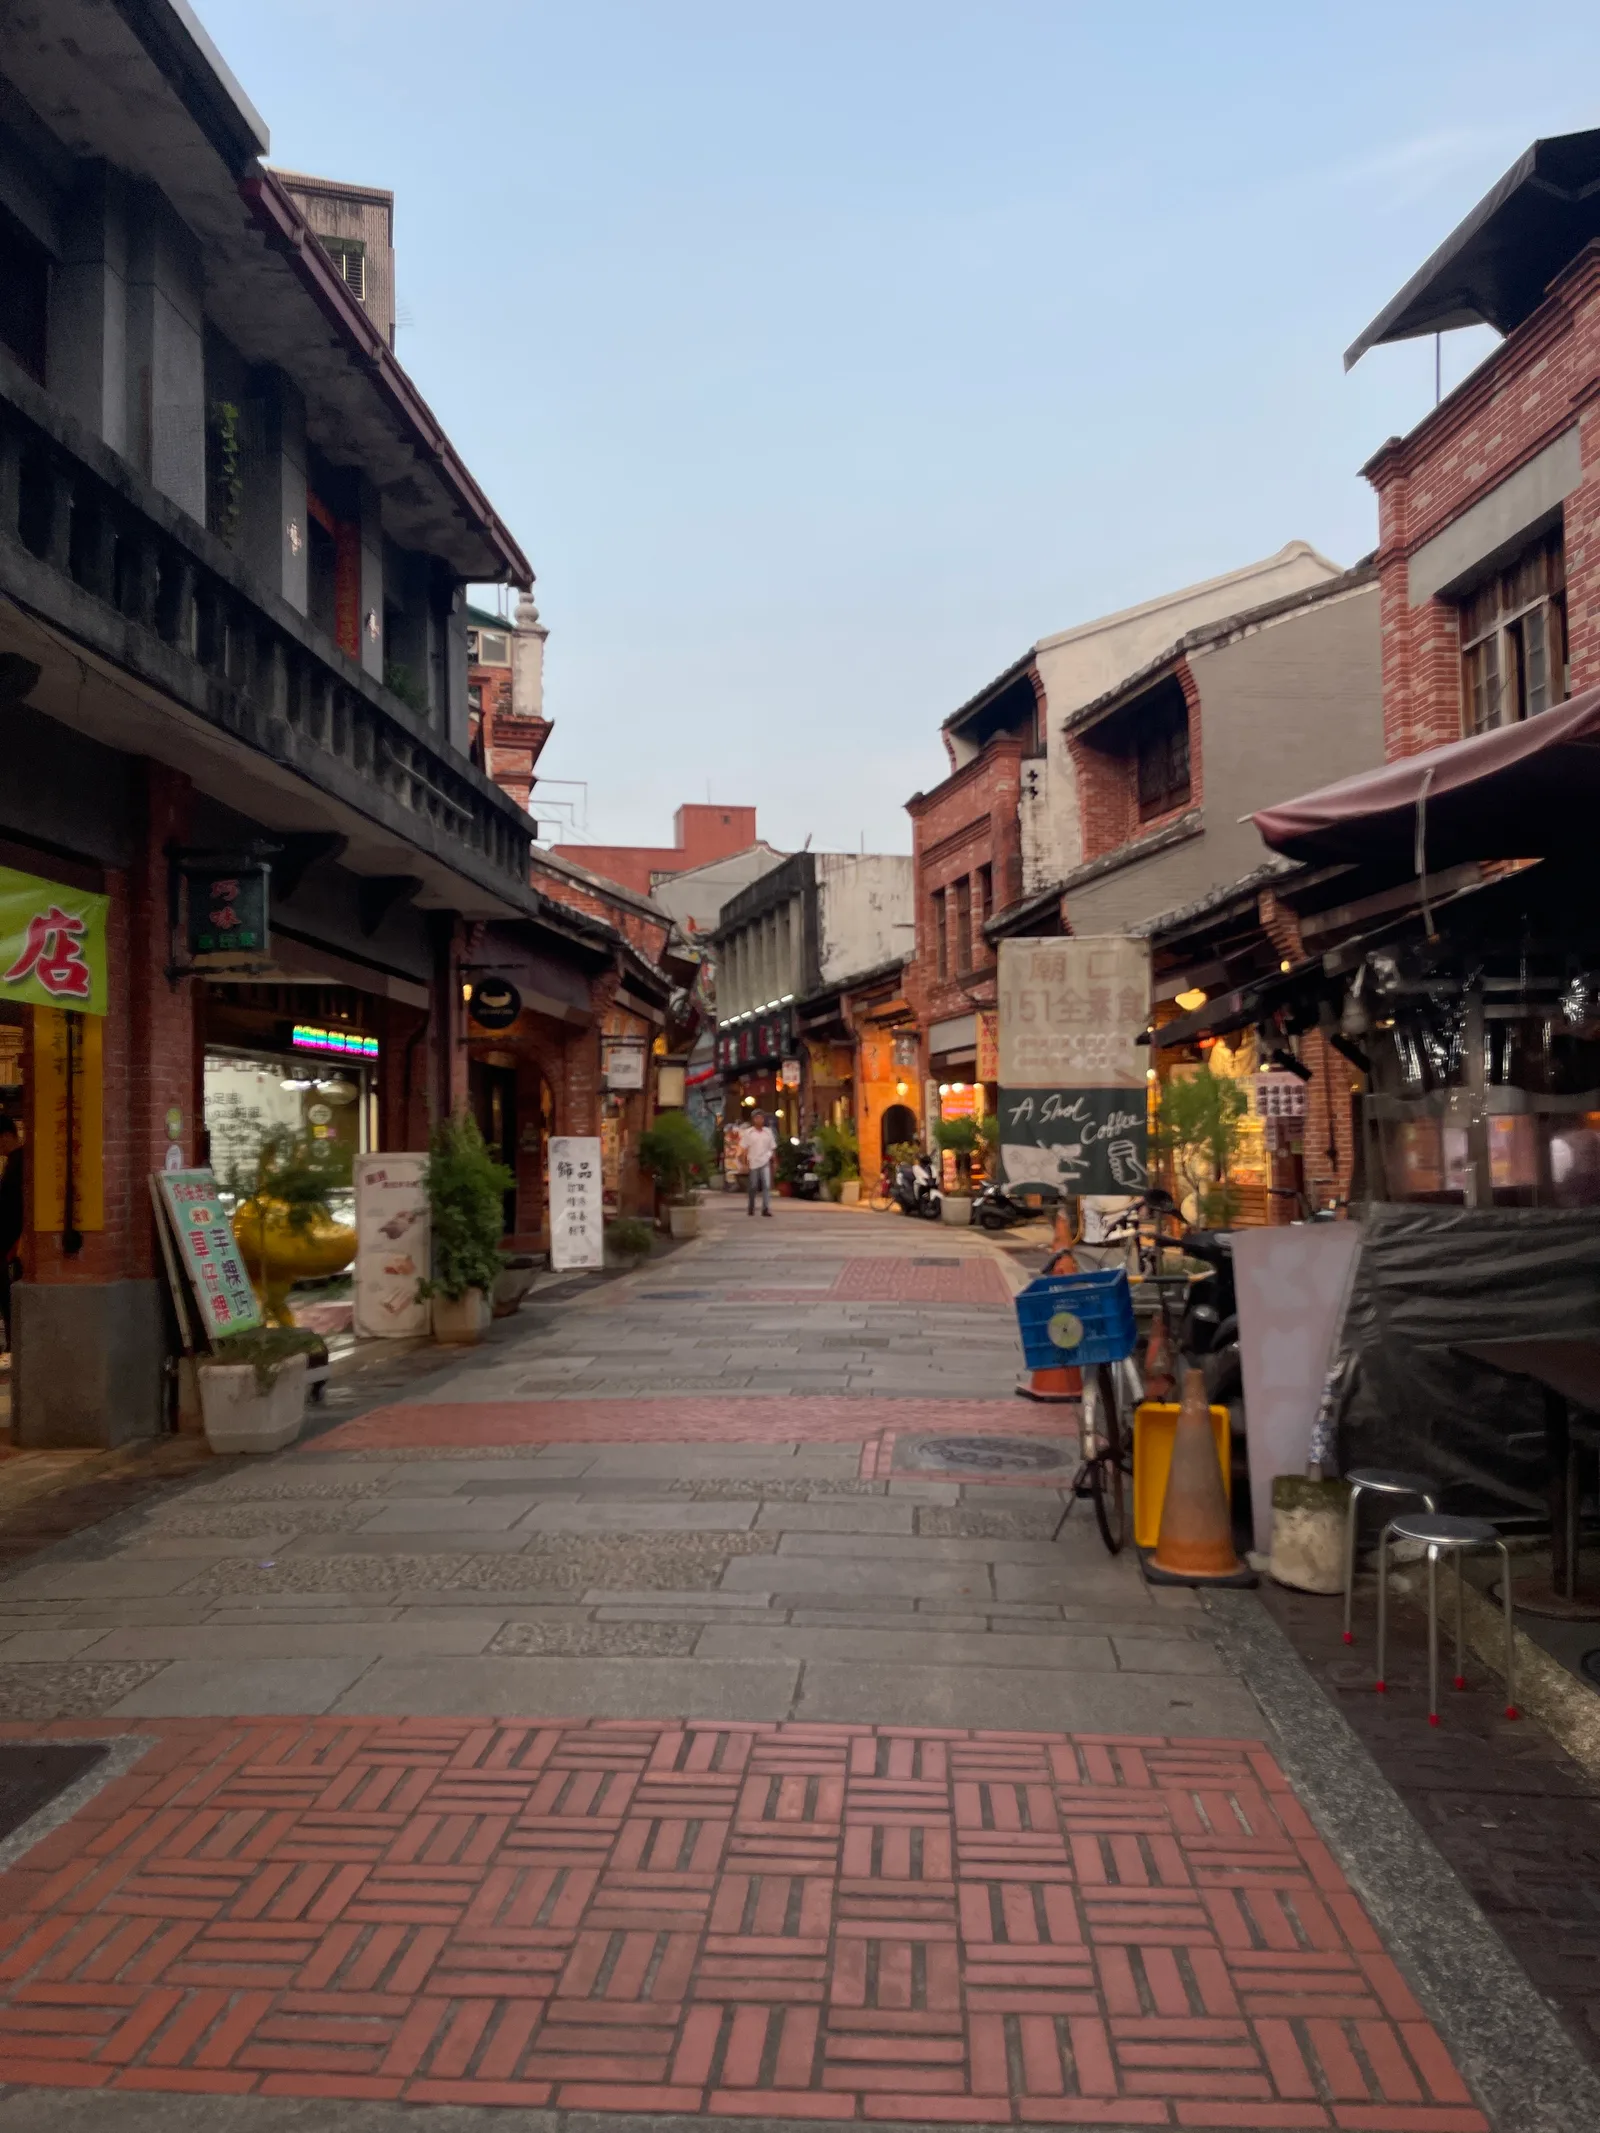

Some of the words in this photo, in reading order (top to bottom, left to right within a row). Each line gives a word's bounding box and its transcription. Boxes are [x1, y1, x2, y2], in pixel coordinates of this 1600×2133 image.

[3, 905, 90, 997] 店
[1030, 951, 1119, 982] 廟口
[1008, 1096, 1034, 1126] A
[1080, 1110, 1145, 1145] Coffee
